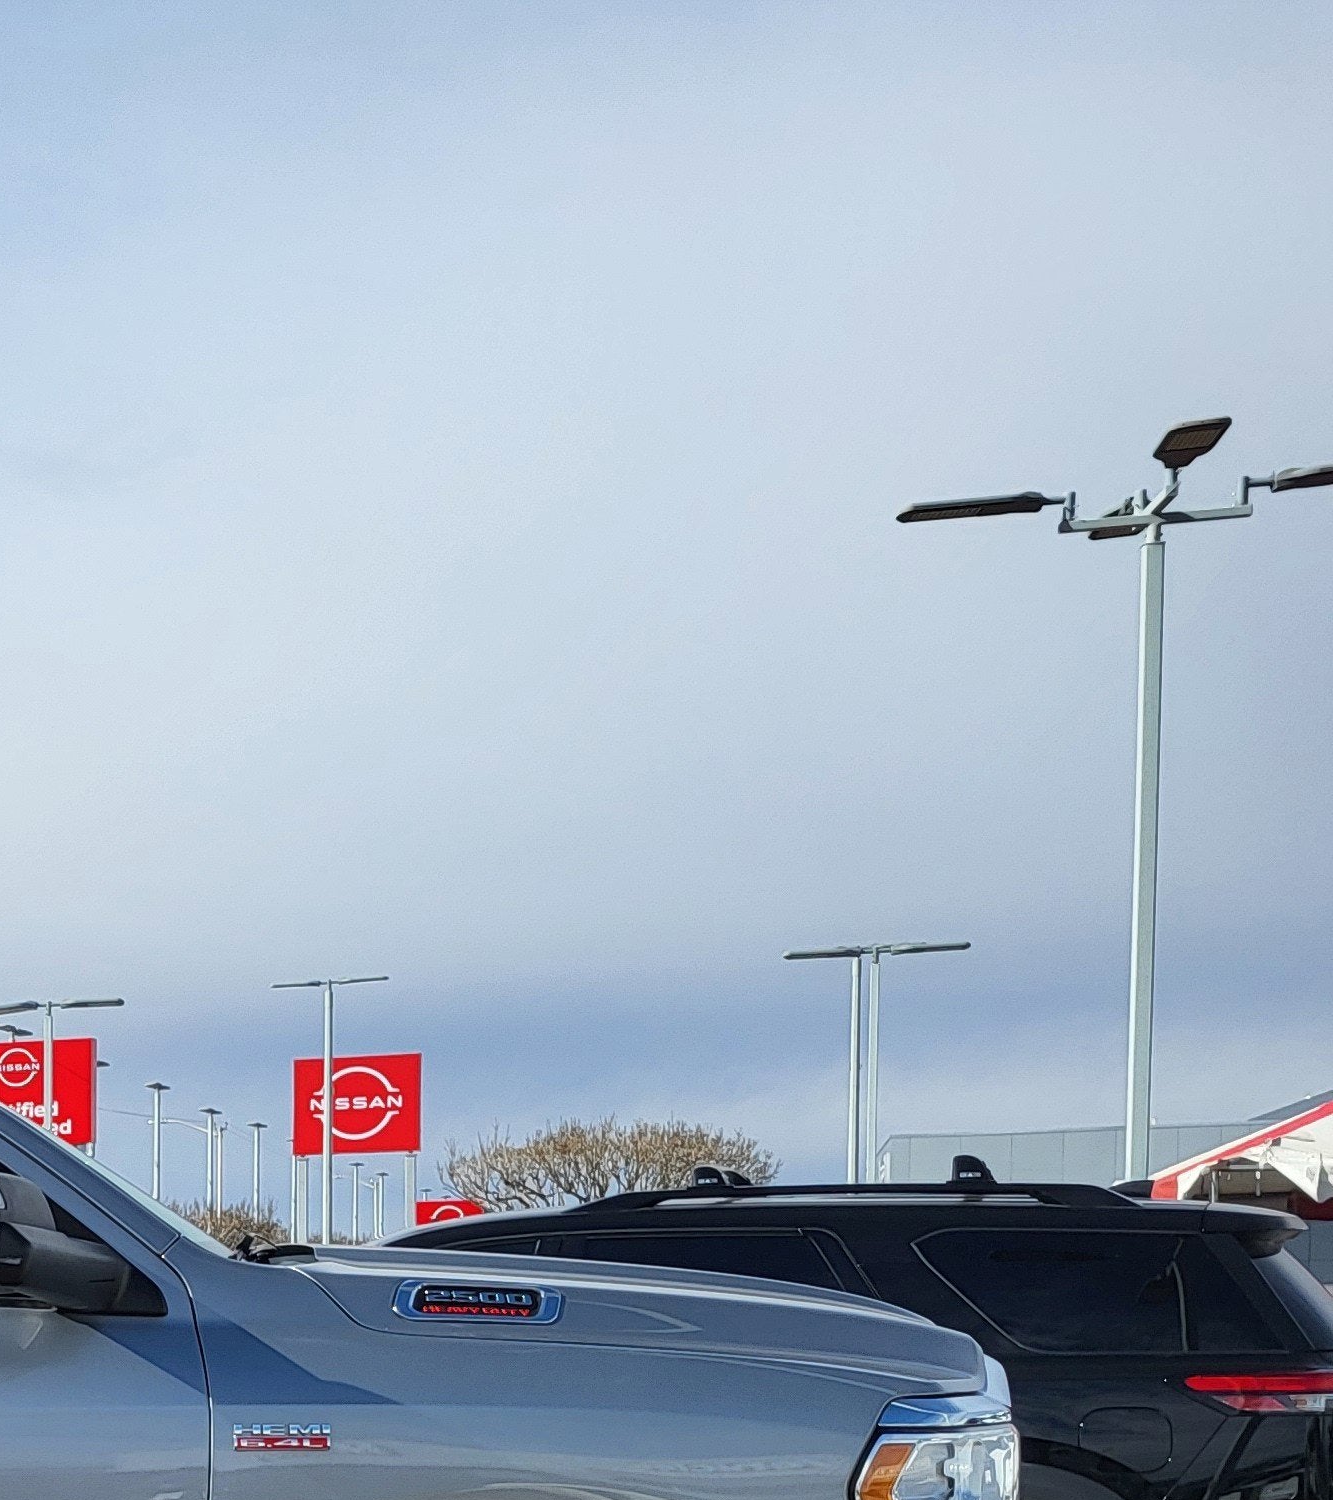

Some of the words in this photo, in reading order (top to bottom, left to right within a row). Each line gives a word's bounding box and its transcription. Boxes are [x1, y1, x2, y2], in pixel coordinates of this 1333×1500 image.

[309, 1095, 403, 1111] NSSAN
[424, 1290, 533, 1306] 2500
[233, 1423, 331, 1436] HEMI
[240, 1438, 324, 1448] 6.4L
